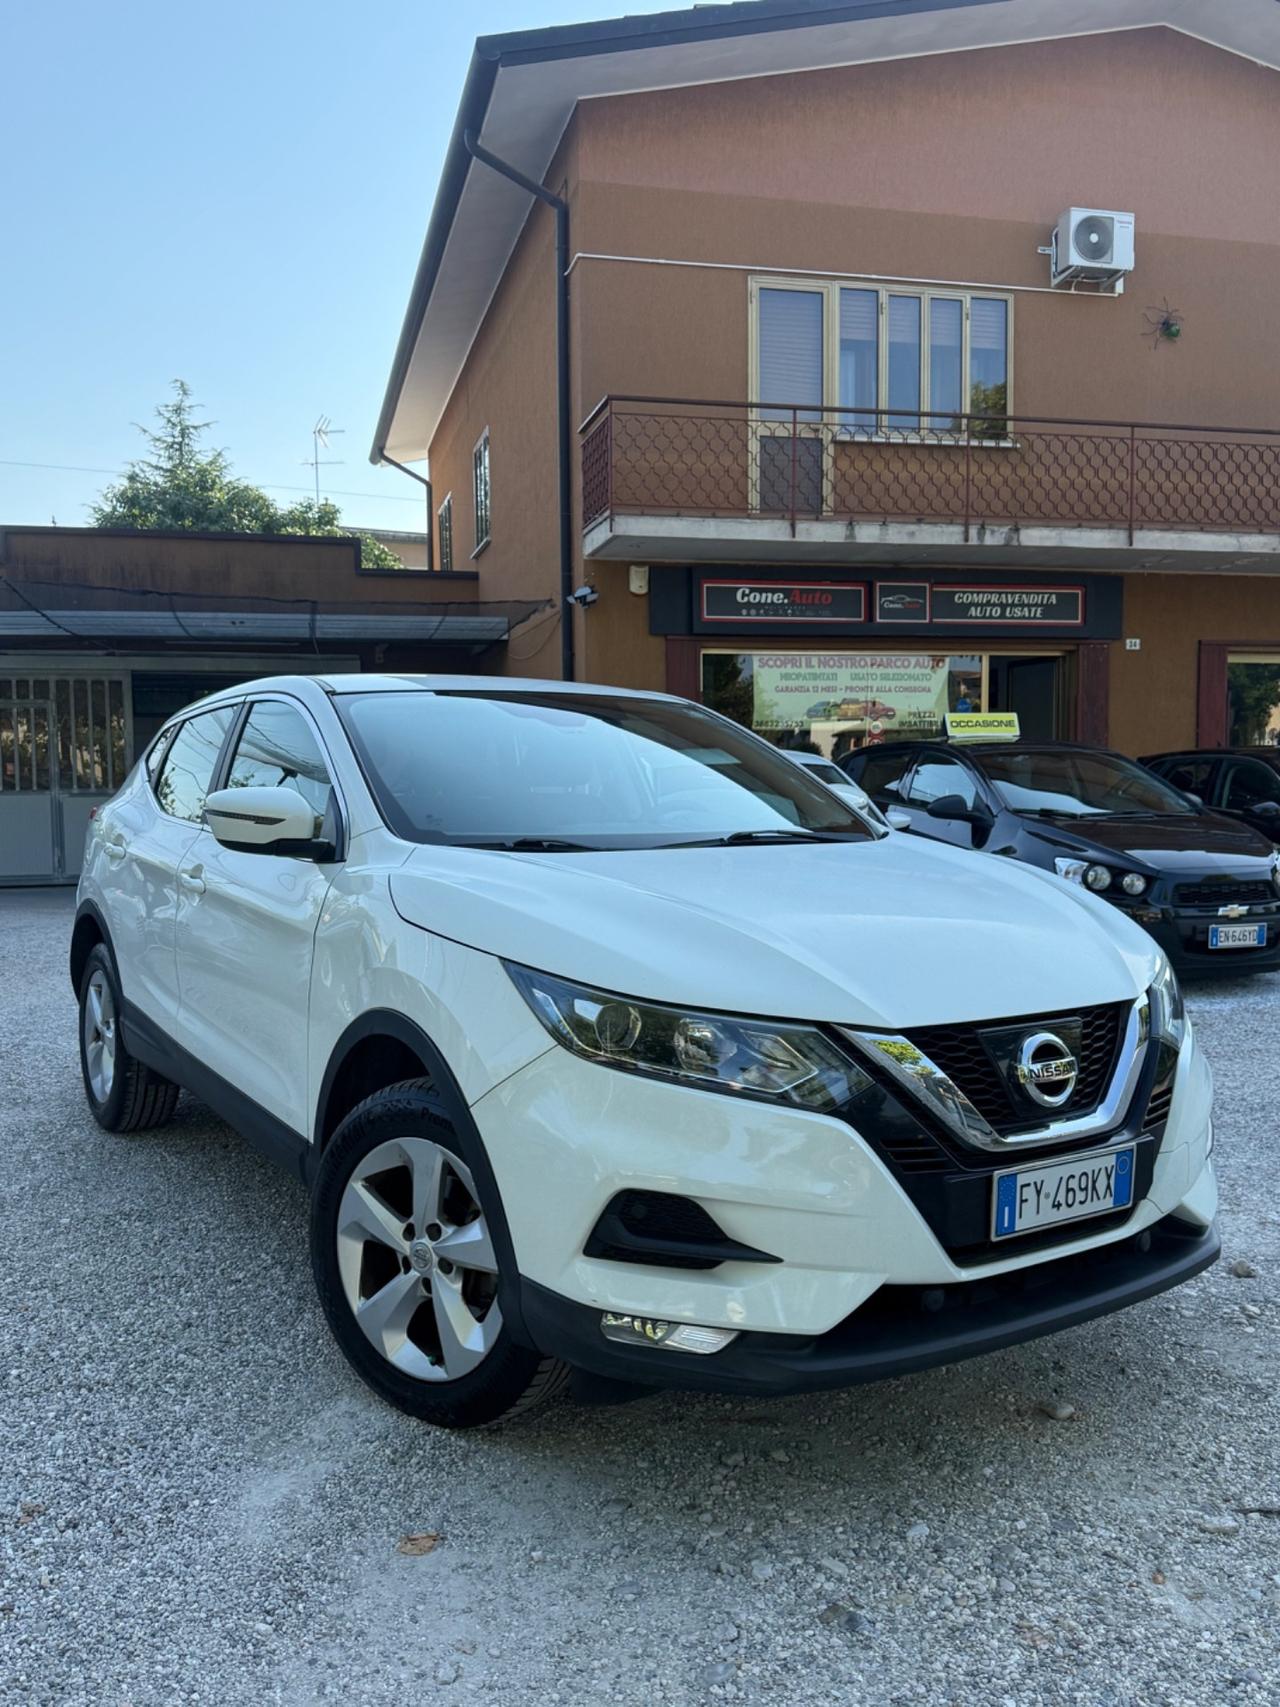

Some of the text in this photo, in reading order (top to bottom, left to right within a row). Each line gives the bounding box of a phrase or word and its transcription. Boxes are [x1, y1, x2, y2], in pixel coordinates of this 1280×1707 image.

[954, 592, 1057, 605] COMPRAVENDITA
[967, 606, 1044, 618] AUTO USATE
[758, 656, 946, 669] SCOPRI IL NOSTRO PARCO AUTO
[779, 672, 933, 682] NEOPATENTATI USATO SELEZIONATO
[774, 685, 811, 694] GARANZIA
[820, 685, 838, 694] MESI
[844, 685, 874, 693] PRONTE
[875, 685, 892, 693] ALLA
[894, 685, 932, 693] CONSEGNA
[950, 719, 1016, 728] OCCASIONE
